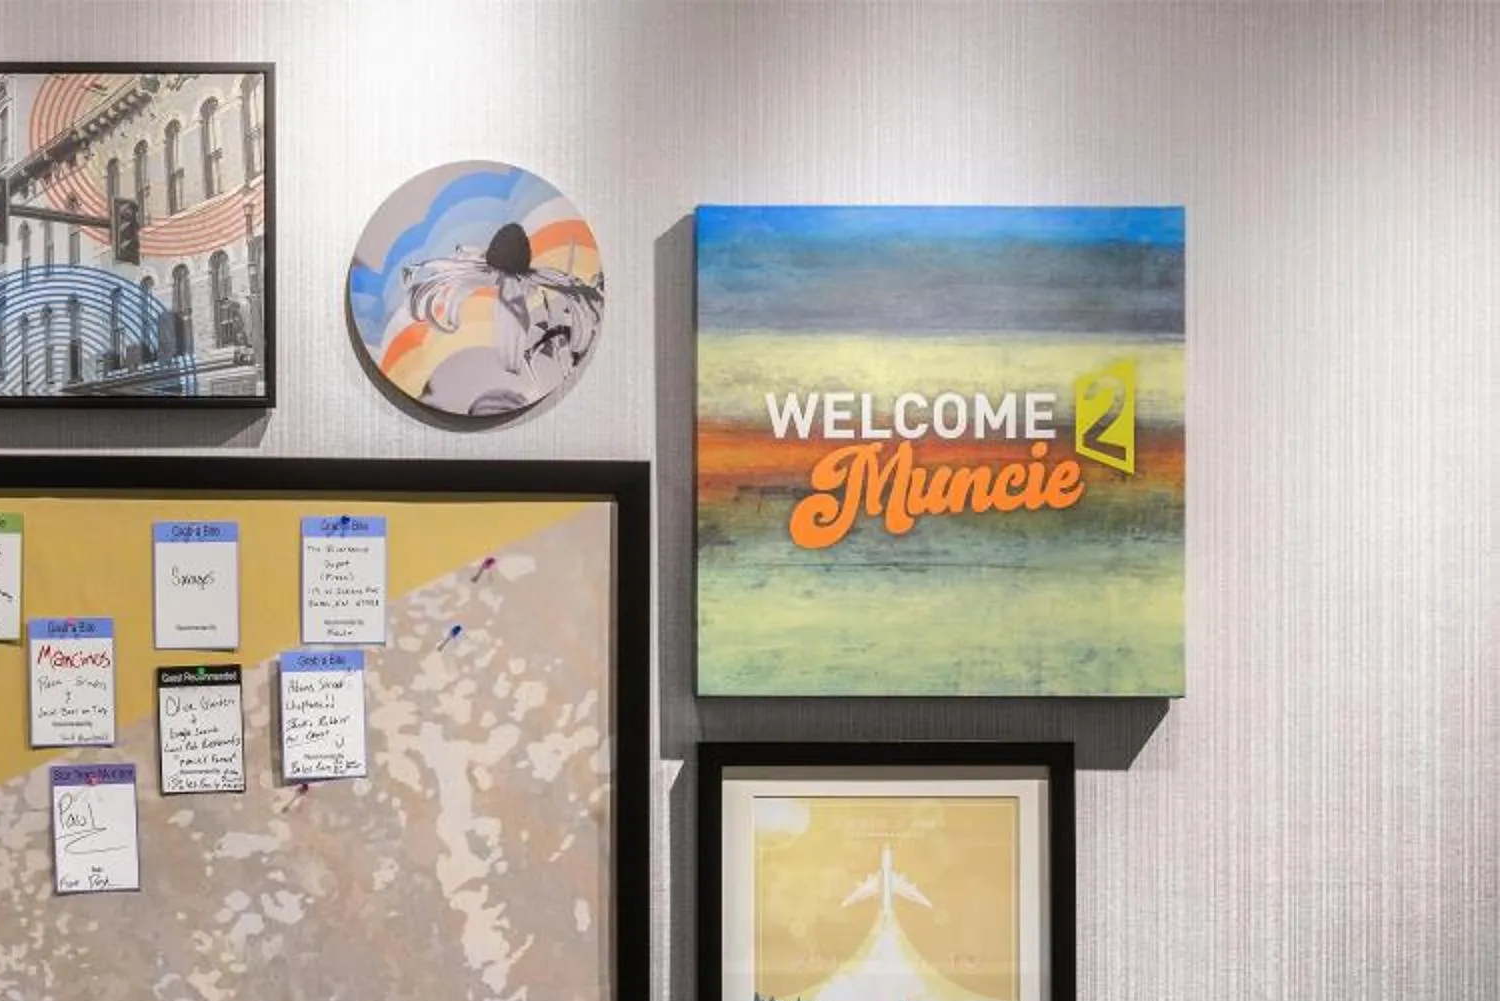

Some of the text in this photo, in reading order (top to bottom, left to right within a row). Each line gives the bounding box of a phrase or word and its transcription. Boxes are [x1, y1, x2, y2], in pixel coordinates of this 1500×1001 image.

[765, 367, 1132, 470] WELCOME 2
[789, 440, 1084, 549] Muncie
